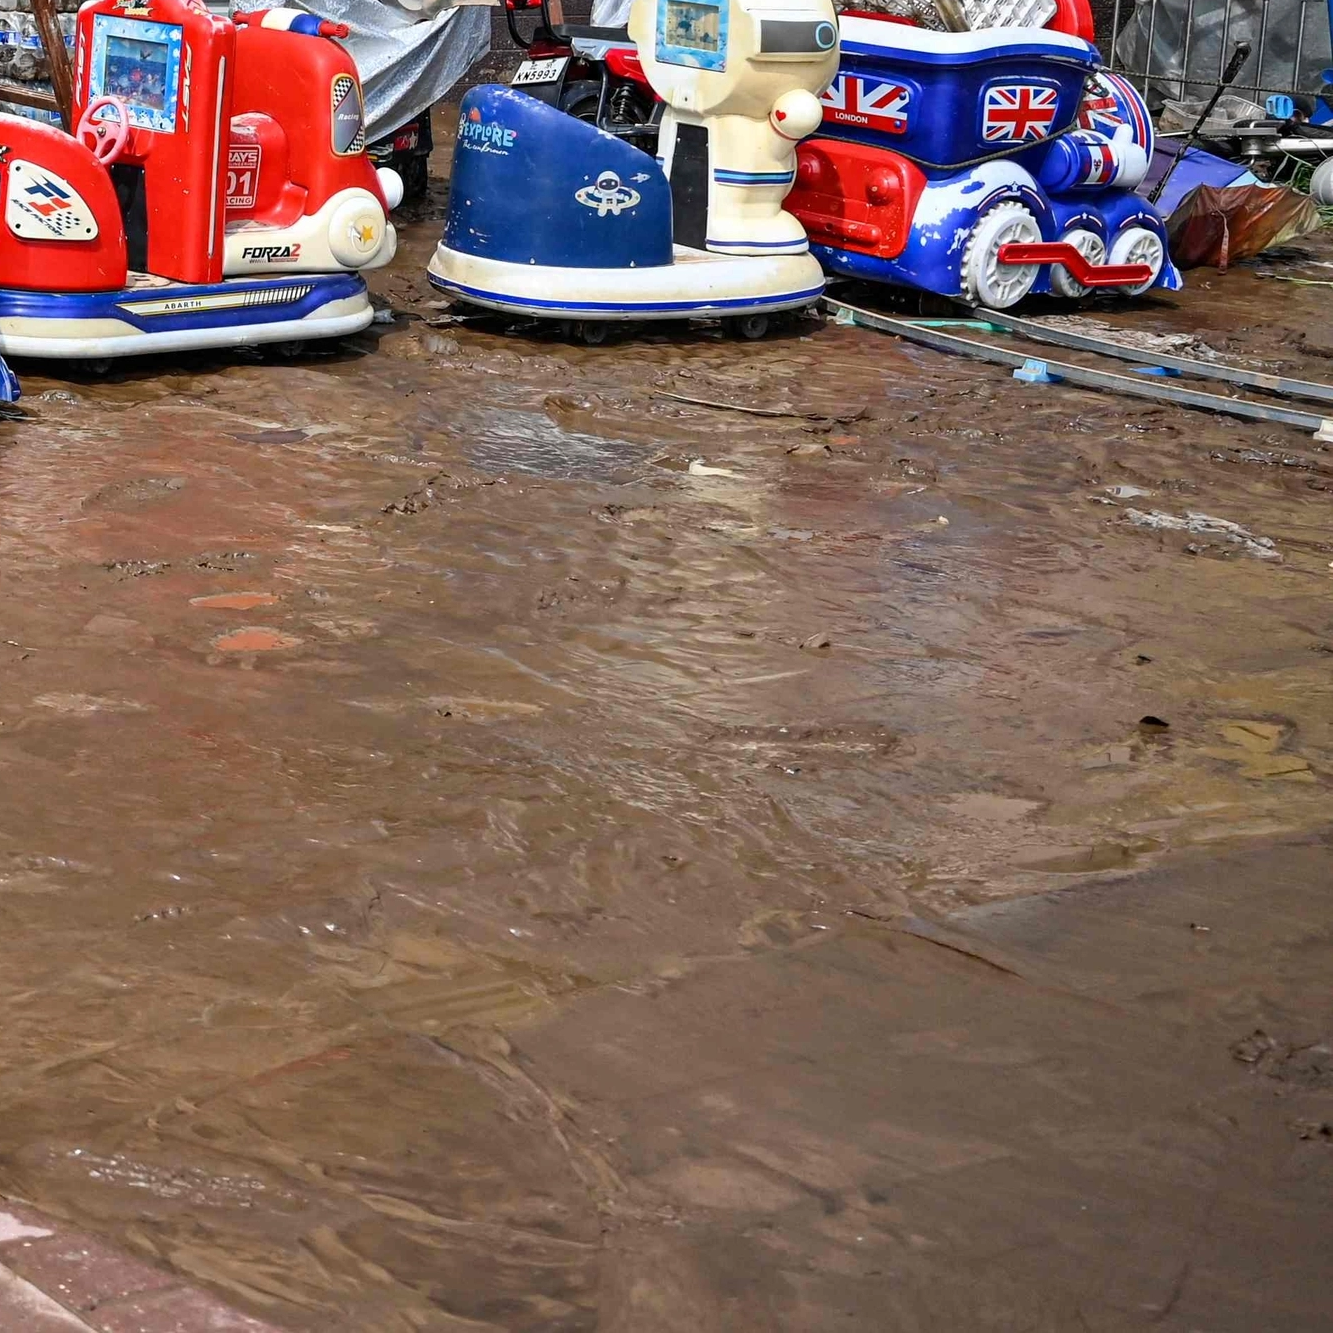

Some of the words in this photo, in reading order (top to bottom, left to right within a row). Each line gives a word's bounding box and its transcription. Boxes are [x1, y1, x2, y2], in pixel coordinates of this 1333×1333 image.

[515, 68, 558, 83] KN5993
[337, 112, 360, 122] Racing
[834, 112, 869, 125] LONDON
[463, 121, 517, 148] EXPLORE
[164, 300, 202, 310] ABARTH
